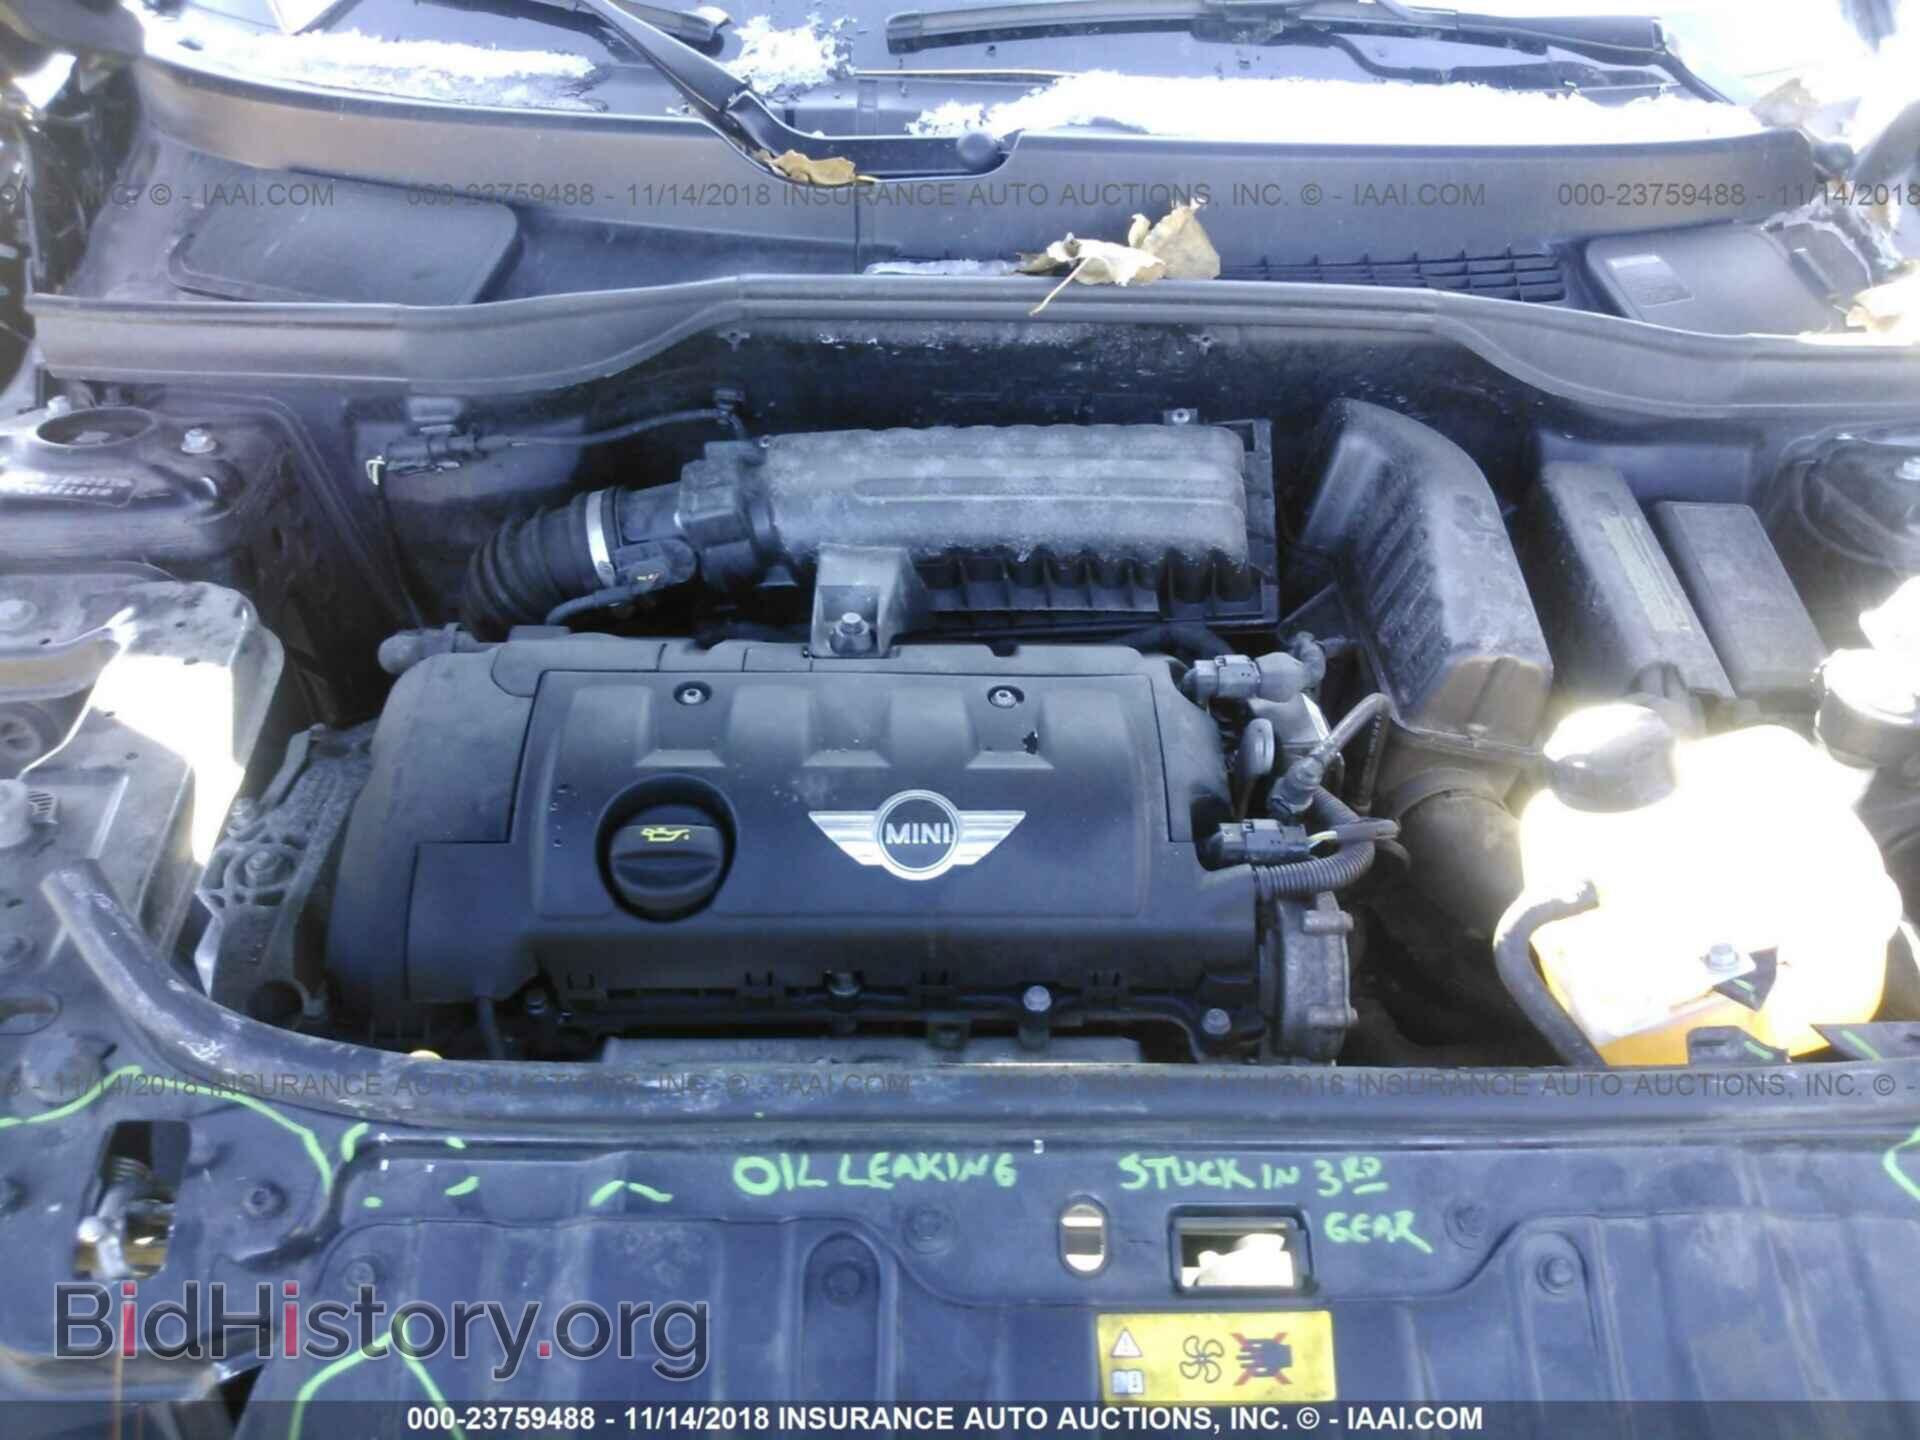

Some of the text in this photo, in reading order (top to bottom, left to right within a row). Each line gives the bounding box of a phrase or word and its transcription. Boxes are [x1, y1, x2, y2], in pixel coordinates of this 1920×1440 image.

[885, 823, 953, 844] MINI
[732, 1151, 1018, 1196] OIL LEAKING
[1118, 1153, 1256, 1190] STUCK
[1262, 1163, 1300, 1190] IN
[1323, 1210, 1434, 1254] GEAR
